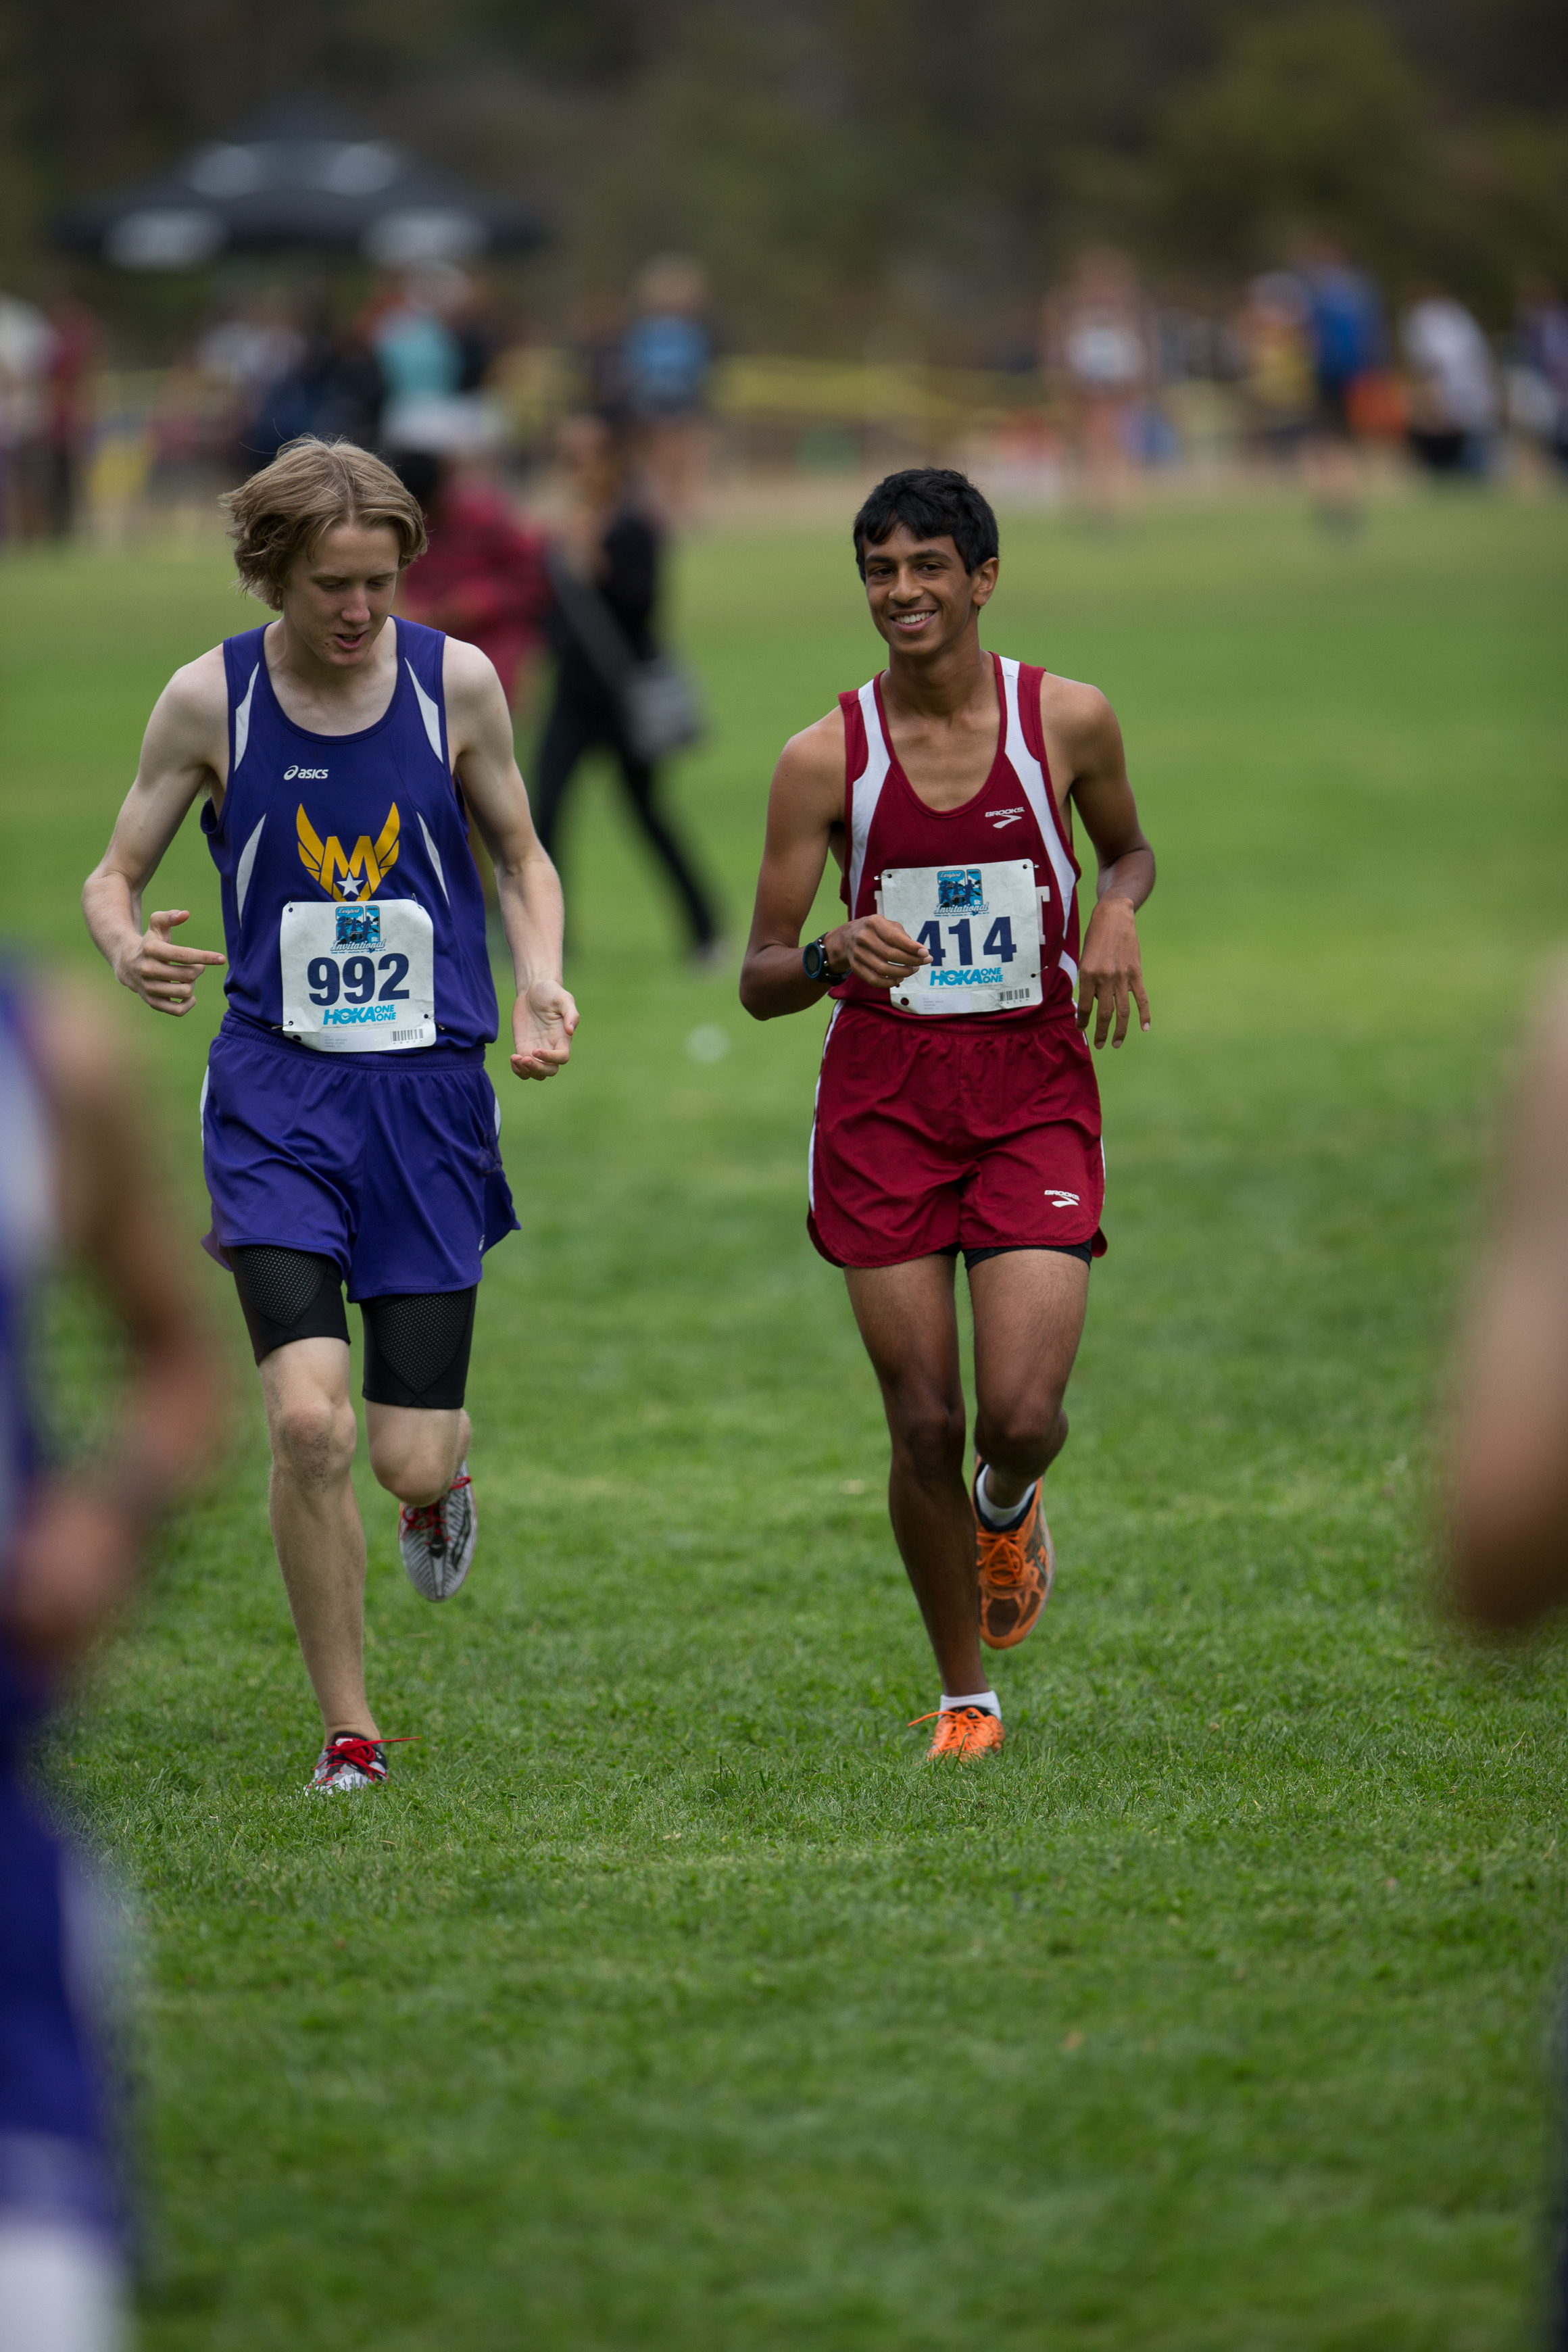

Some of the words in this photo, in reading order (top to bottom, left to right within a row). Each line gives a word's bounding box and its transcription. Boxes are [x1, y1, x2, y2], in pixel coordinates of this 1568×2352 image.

[297, 768, 329, 779] asics
[985, 806, 1025, 818] BROOKS
[933, 901, 989, 914] Invitational
[330, 939, 387, 952] Invitational
[916, 916, 1017, 966] 414
[307, 953, 410, 1006] 992
[929, 969, 983, 986] HOKA
[980, 967, 1002, 976] ONE
[982, 975, 1004, 983] ONE
[323, 1006, 376, 1025] HOKA
[374, 1004, 395, 1013] ONE
[376, 1012, 396, 1021] ONE
[1044, 1190, 1080, 1201] BROOKS
